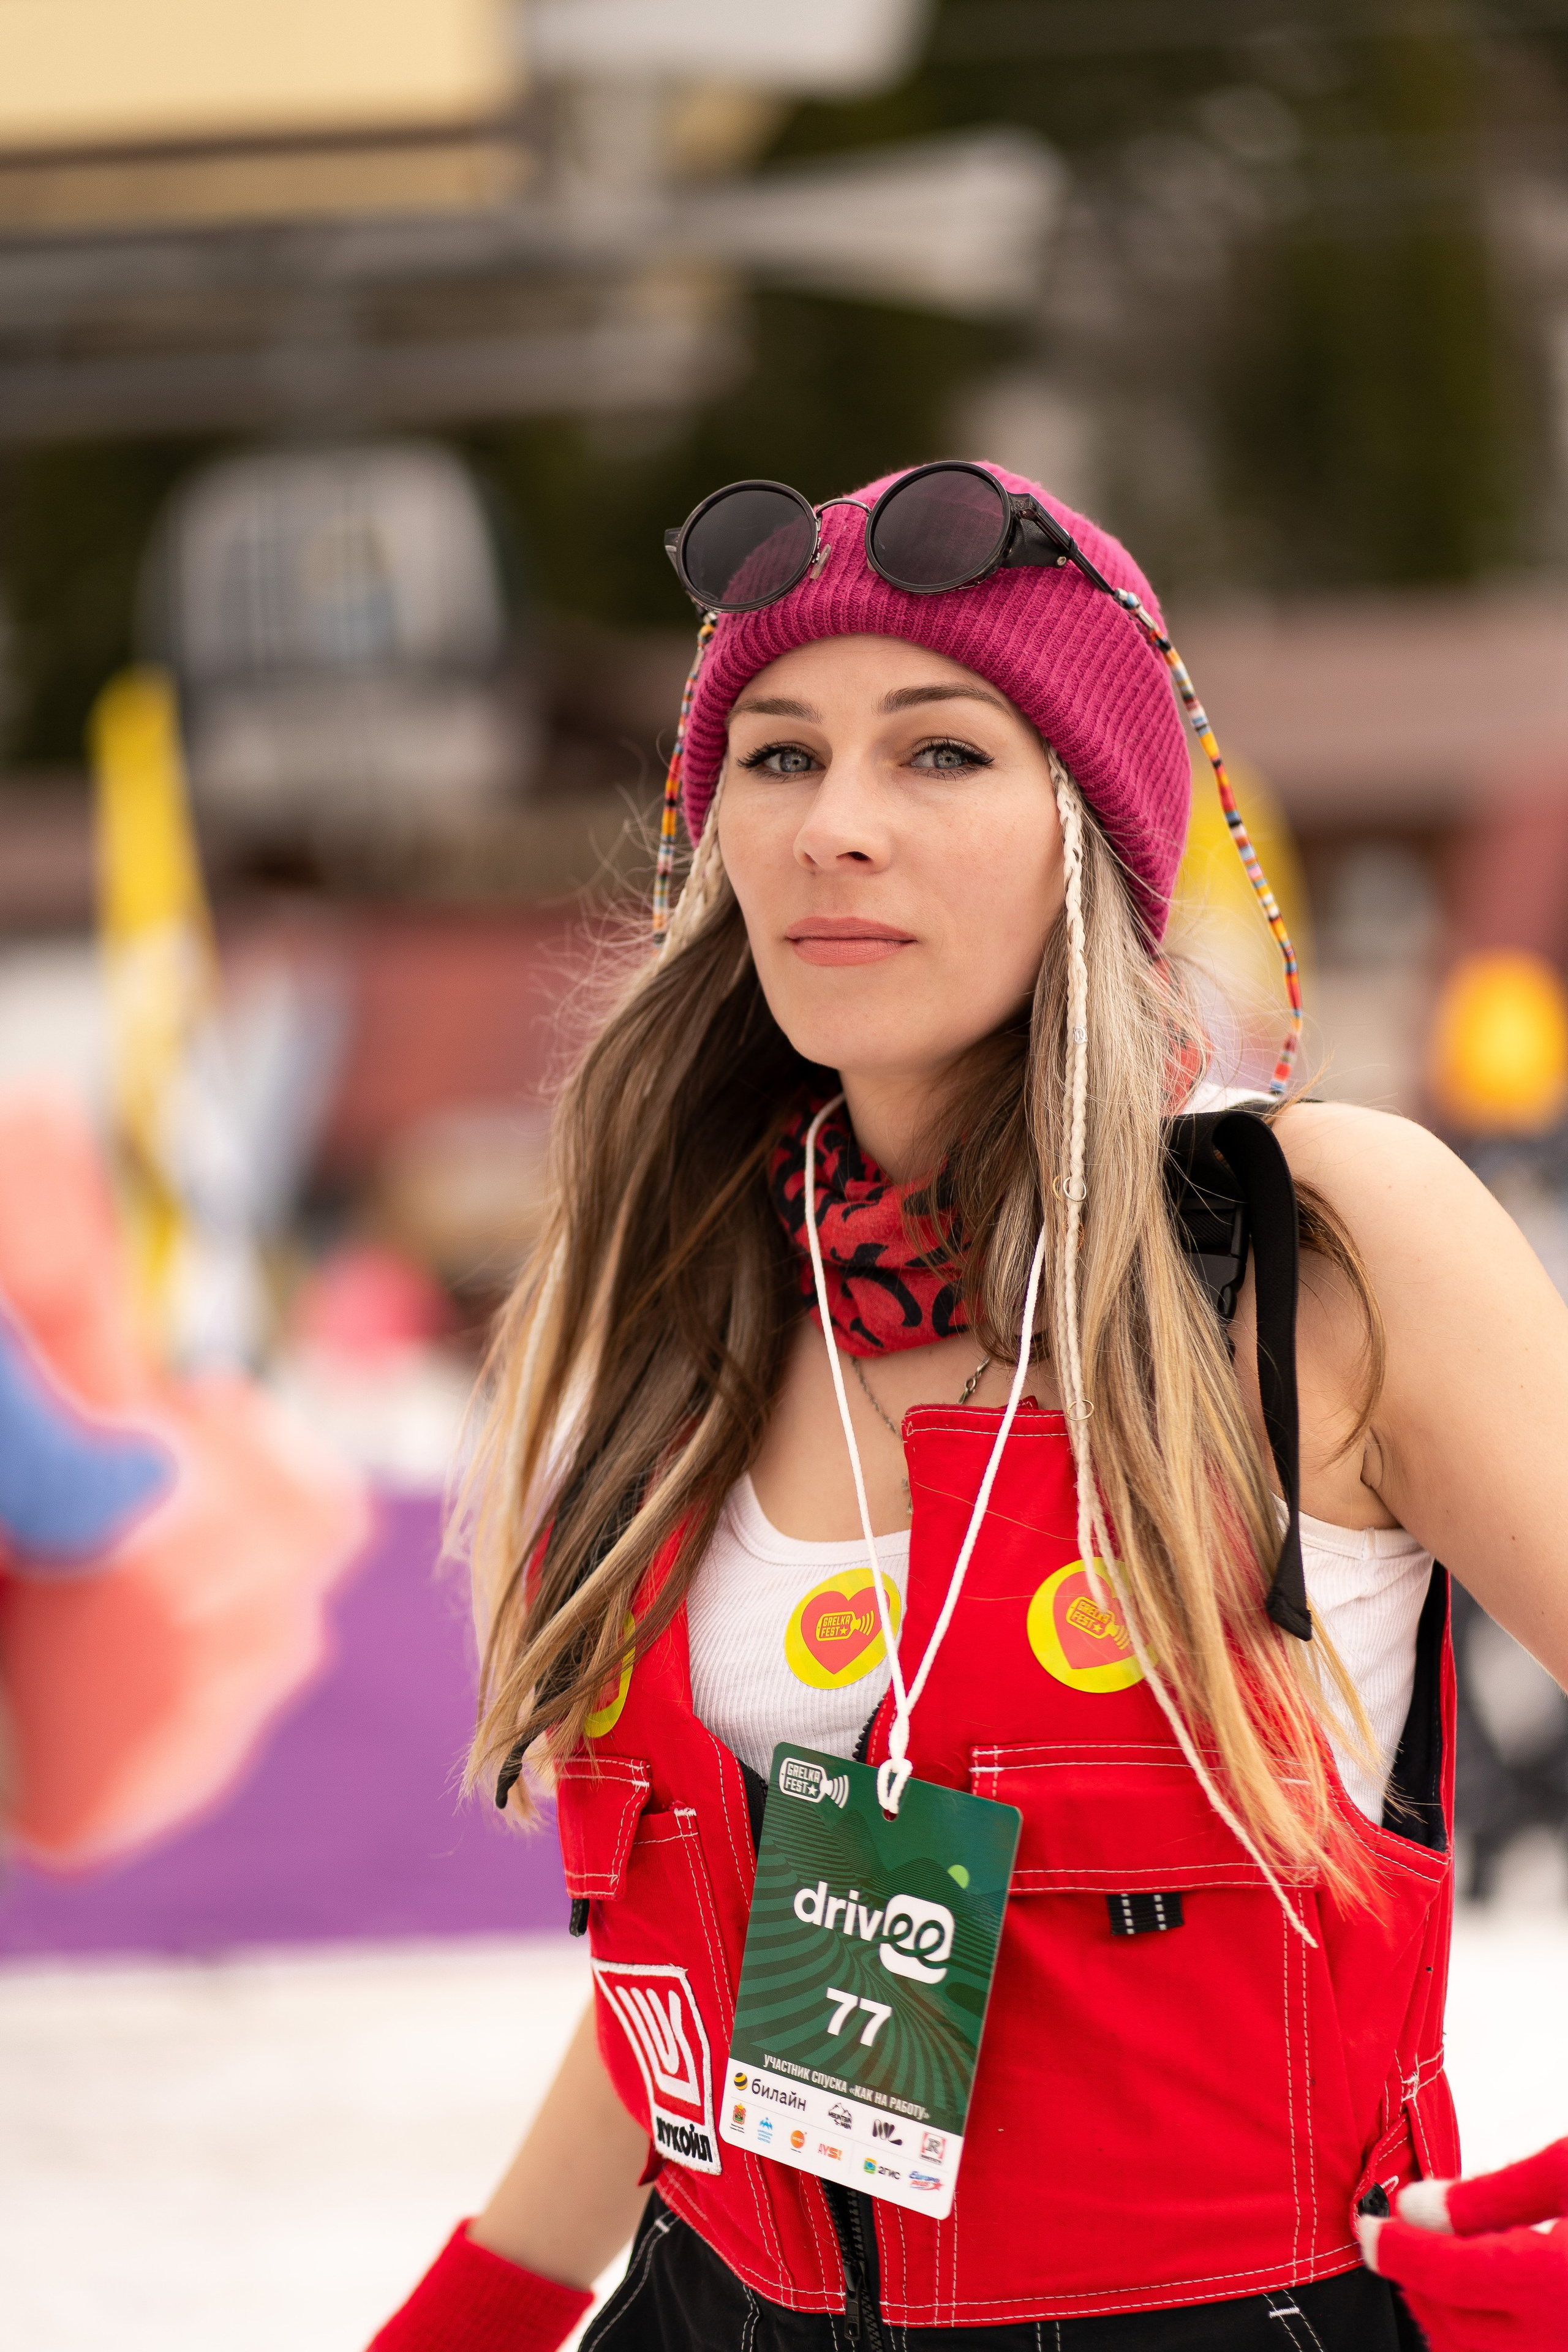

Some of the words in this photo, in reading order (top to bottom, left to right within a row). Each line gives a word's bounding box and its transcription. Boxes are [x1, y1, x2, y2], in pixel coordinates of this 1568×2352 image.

[823, 1615, 851, 1627] GRELKA
[1071, 1611, 1096, 1628] FEST
[821, 1626, 840, 1637] FEST
[787, 1763, 821, 1784] GRELKA
[785, 1776, 809, 1794] FEST
[793, 1880, 954, 1984] drivee
[826, 1986, 892, 2047] 77
[763, 2054, 810, 2081] УЧАСТНИК
[811, 2071, 847, 2094] СПУСКА
[874, 2091, 888, 2107] НА
[751, 2078, 807, 2111] билайн
[878, 2166, 902, 2180] 2ГИС
